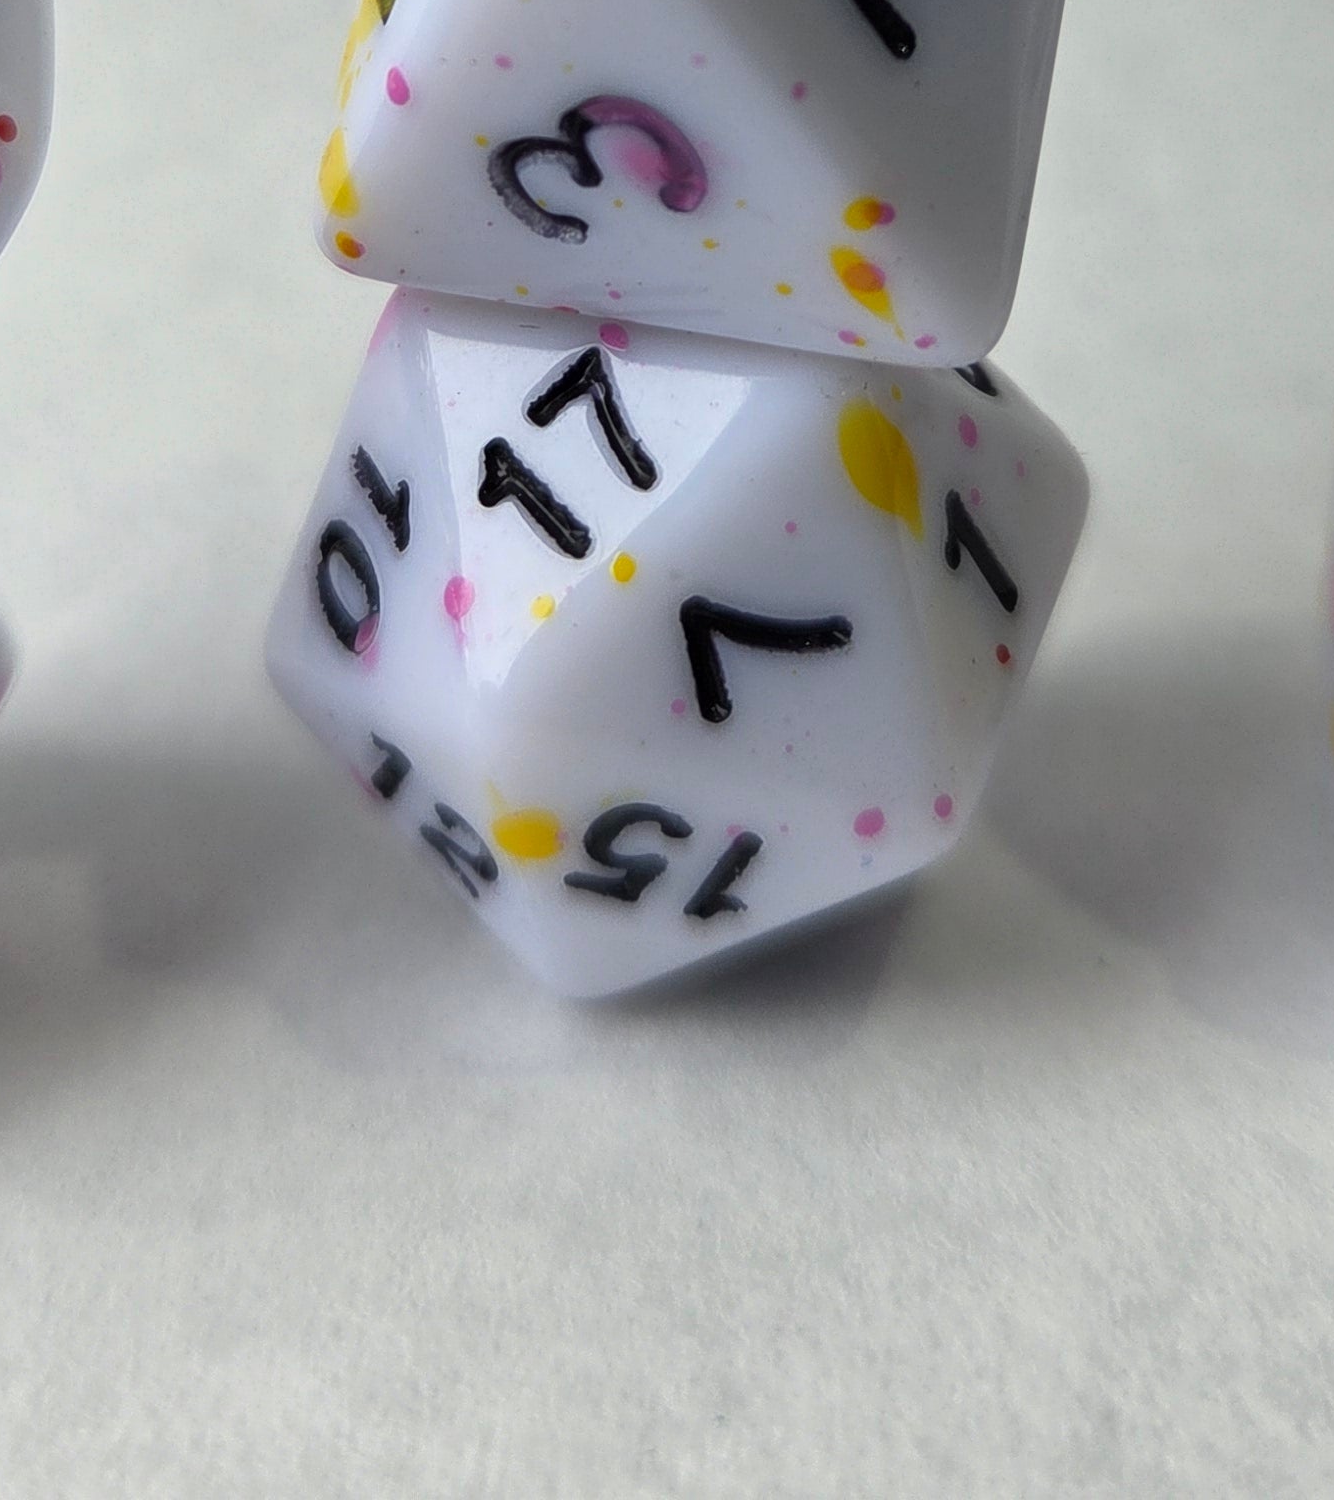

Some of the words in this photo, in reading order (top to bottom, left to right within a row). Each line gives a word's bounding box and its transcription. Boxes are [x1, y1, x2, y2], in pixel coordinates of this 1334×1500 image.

[488, 95, 707, 244] 3
[479, 347, 659, 558] 17
[316, 447, 411, 653] 10
[945, 489, 1017, 613] 1
[679, 596, 853, 722] 7
[565, 803, 765, 918] 15
